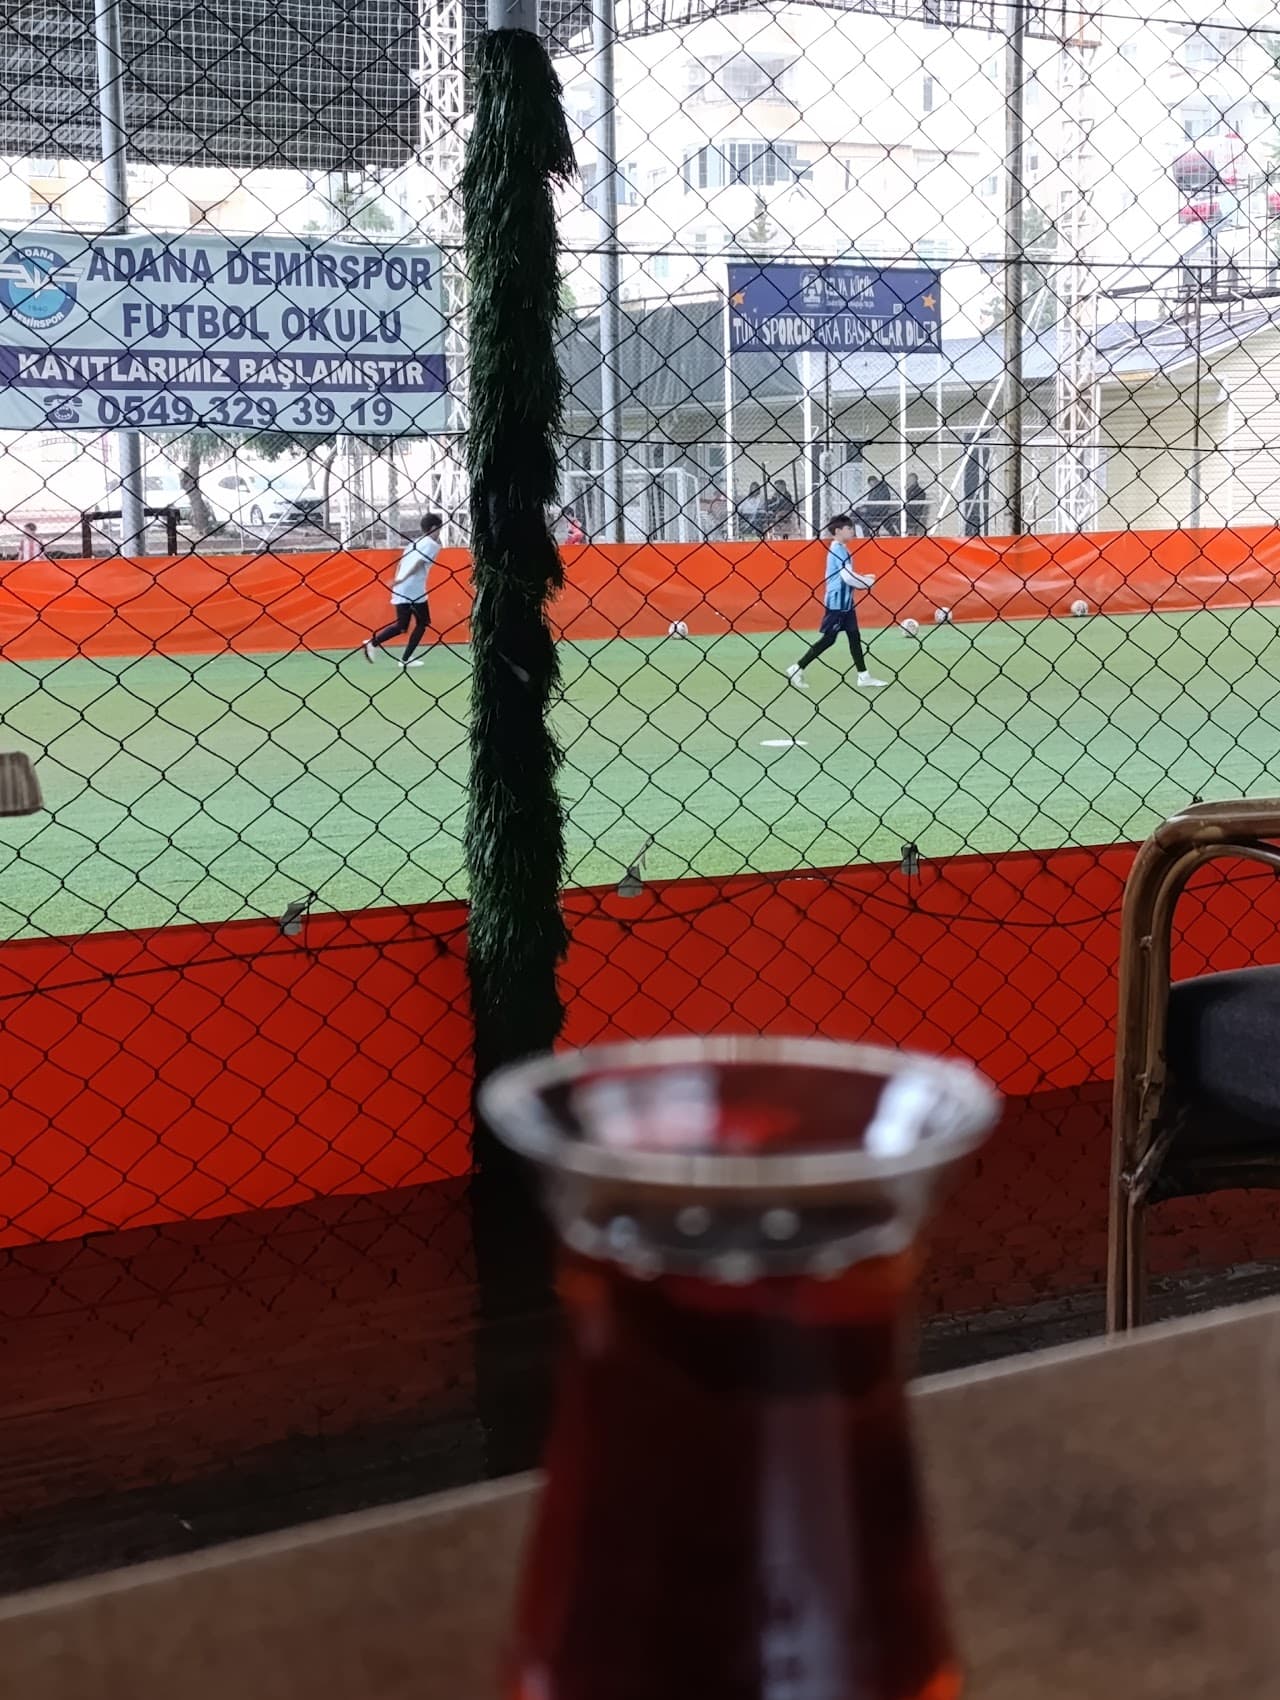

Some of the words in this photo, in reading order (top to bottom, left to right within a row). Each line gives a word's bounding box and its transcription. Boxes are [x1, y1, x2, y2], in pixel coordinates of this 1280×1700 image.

[87, 246, 214, 284] ADANA
[226, 244, 432, 290] DEMİRSPOR
[123, 303, 269, 340] FUTBOL
[281, 306, 402, 343] OKULU
[762, 317, 841, 345] SPORCULARA
[18, 353, 231, 383] KAYITLARIMIZ
[239, 358, 424, 391] BAŞLAMIŞTIR
[98, 395, 193, 425] 0549
[208, 397, 277, 425] 329
[292, 398, 335, 426] 39
[350, 398, 393, 426] 19
